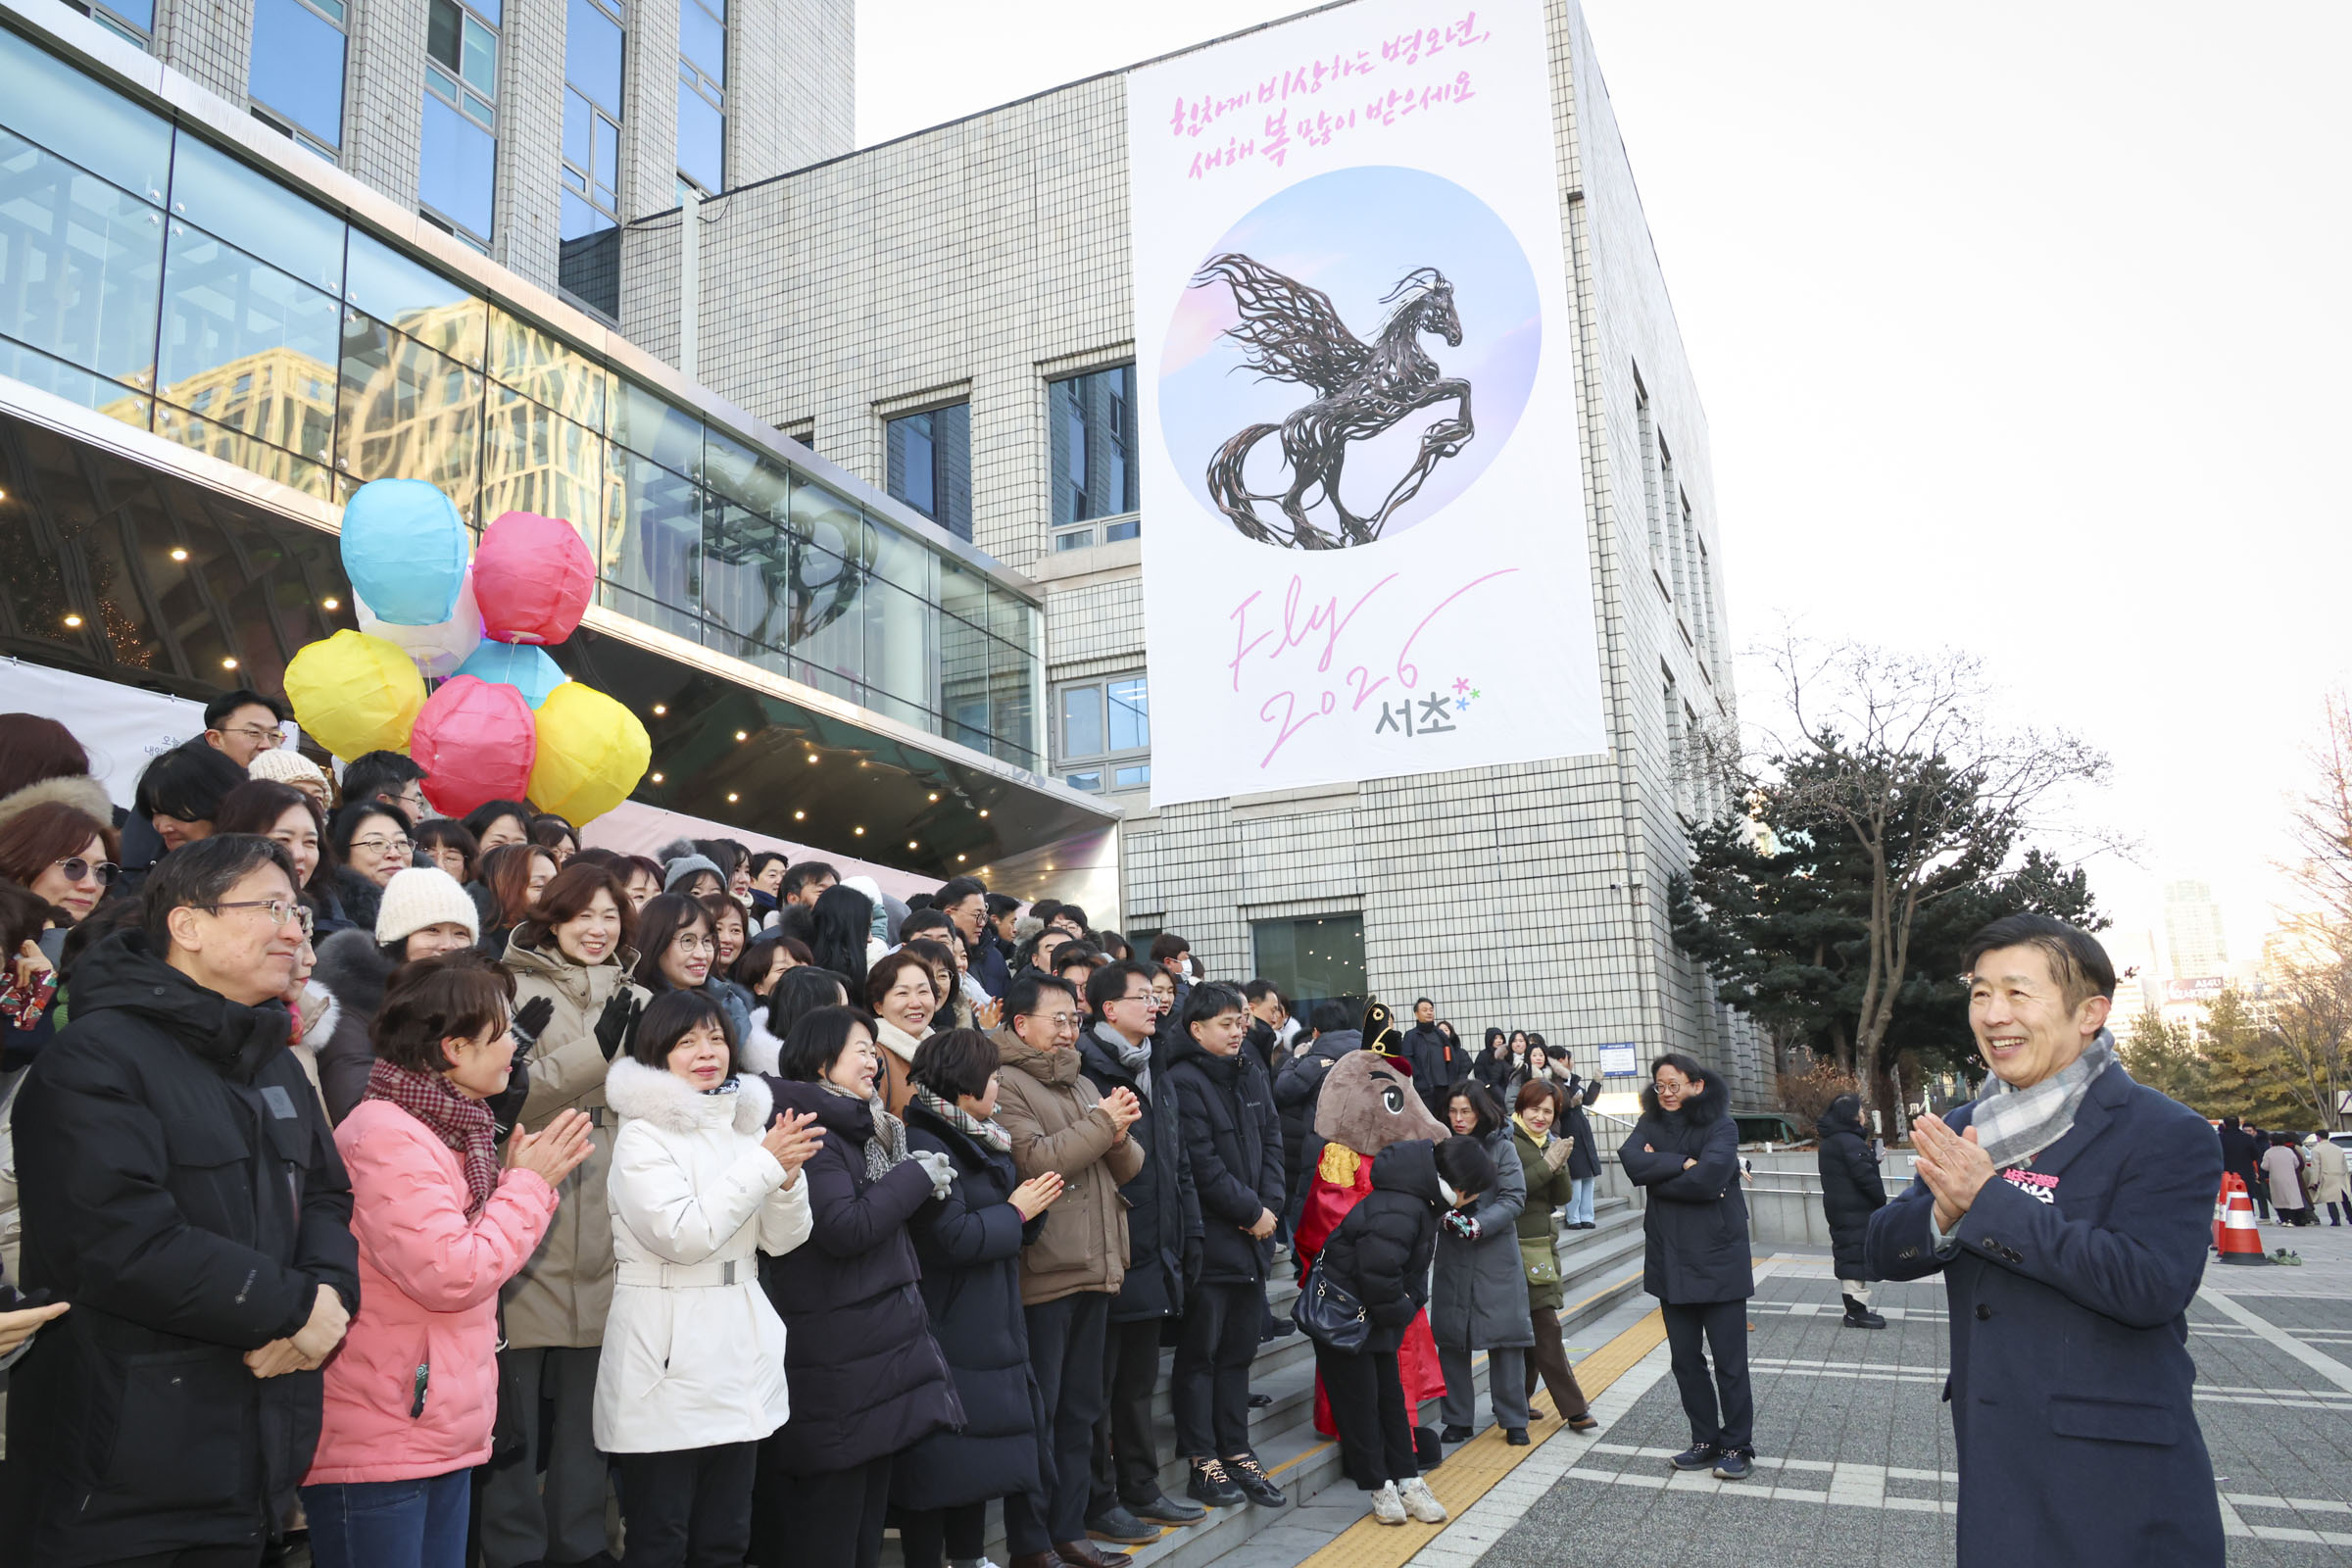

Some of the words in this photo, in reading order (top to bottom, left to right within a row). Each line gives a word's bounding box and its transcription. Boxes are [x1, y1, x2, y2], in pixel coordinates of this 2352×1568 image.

[1169, 91, 1251, 137] 힘차게
[1257, 51, 1376, 102] 비상하는
[1381, 11, 1491, 65] 병오년,
[1188, 136, 1254, 179] 새해
[1260, 108, 1292, 167] 복
[1297, 110, 1356, 147] 많이
[1365, 71, 1476, 126] 받으세요
[1228, 572, 1399, 692] Fly
[1259, 567, 1521, 769] 2026
[1375, 691, 1456, 737] 서초
[2002, 1168, 2060, 1189] 서초구청장
